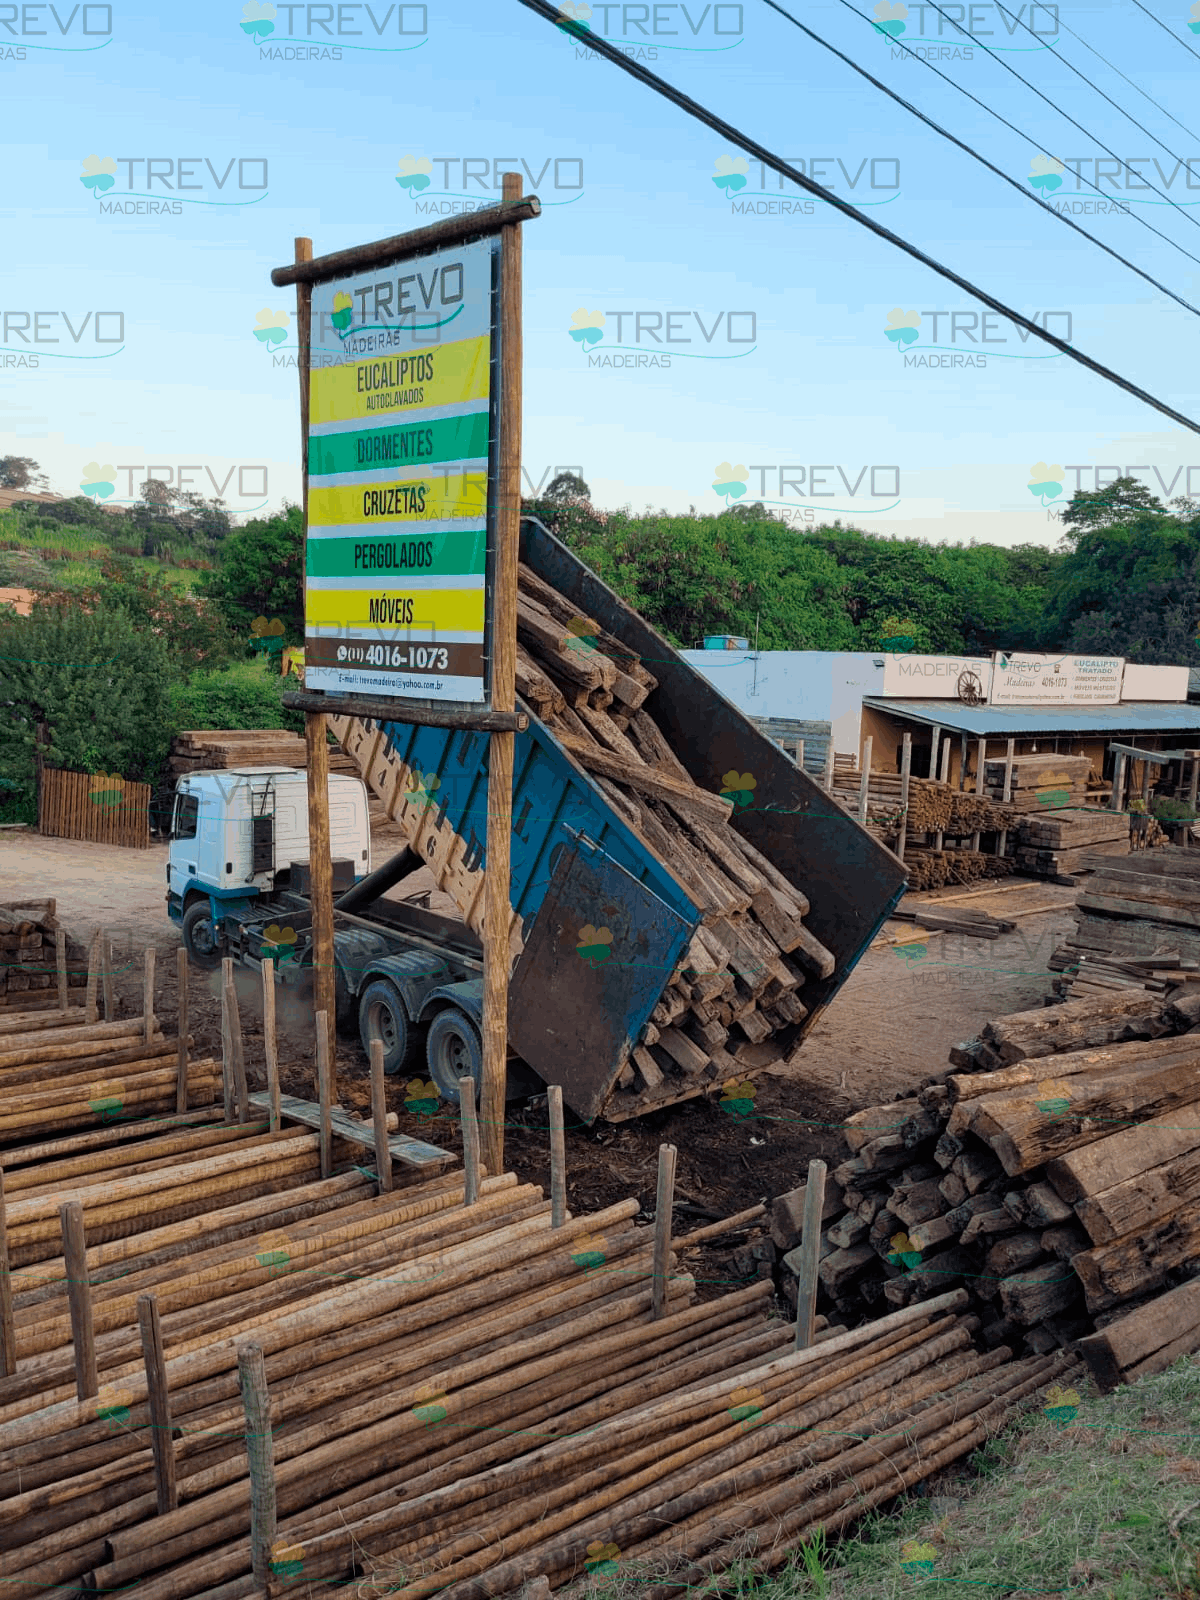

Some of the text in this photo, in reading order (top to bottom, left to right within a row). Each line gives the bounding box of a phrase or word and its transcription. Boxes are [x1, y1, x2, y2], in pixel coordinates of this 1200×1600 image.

[354, 262, 464, 324] TREVO
[343, 330, 400, 356] MADEIRAS
[357, 353, 434, 392] EUCALIPTOS
[366, 387, 424, 411] AUTOCLAVADOS
[357, 428, 433, 464] DORMENTES
[363, 486, 426, 516] CRUZETAS
[354, 541, 433, 569] PERGOLADOS
[369, 593, 414, 624] MÓVEIS
[348, 644, 449, 670] (11) 4016-1073
[1007, 660, 1042, 672] TREVO
[1074, 660, 1119, 668] EUCALIPTO
